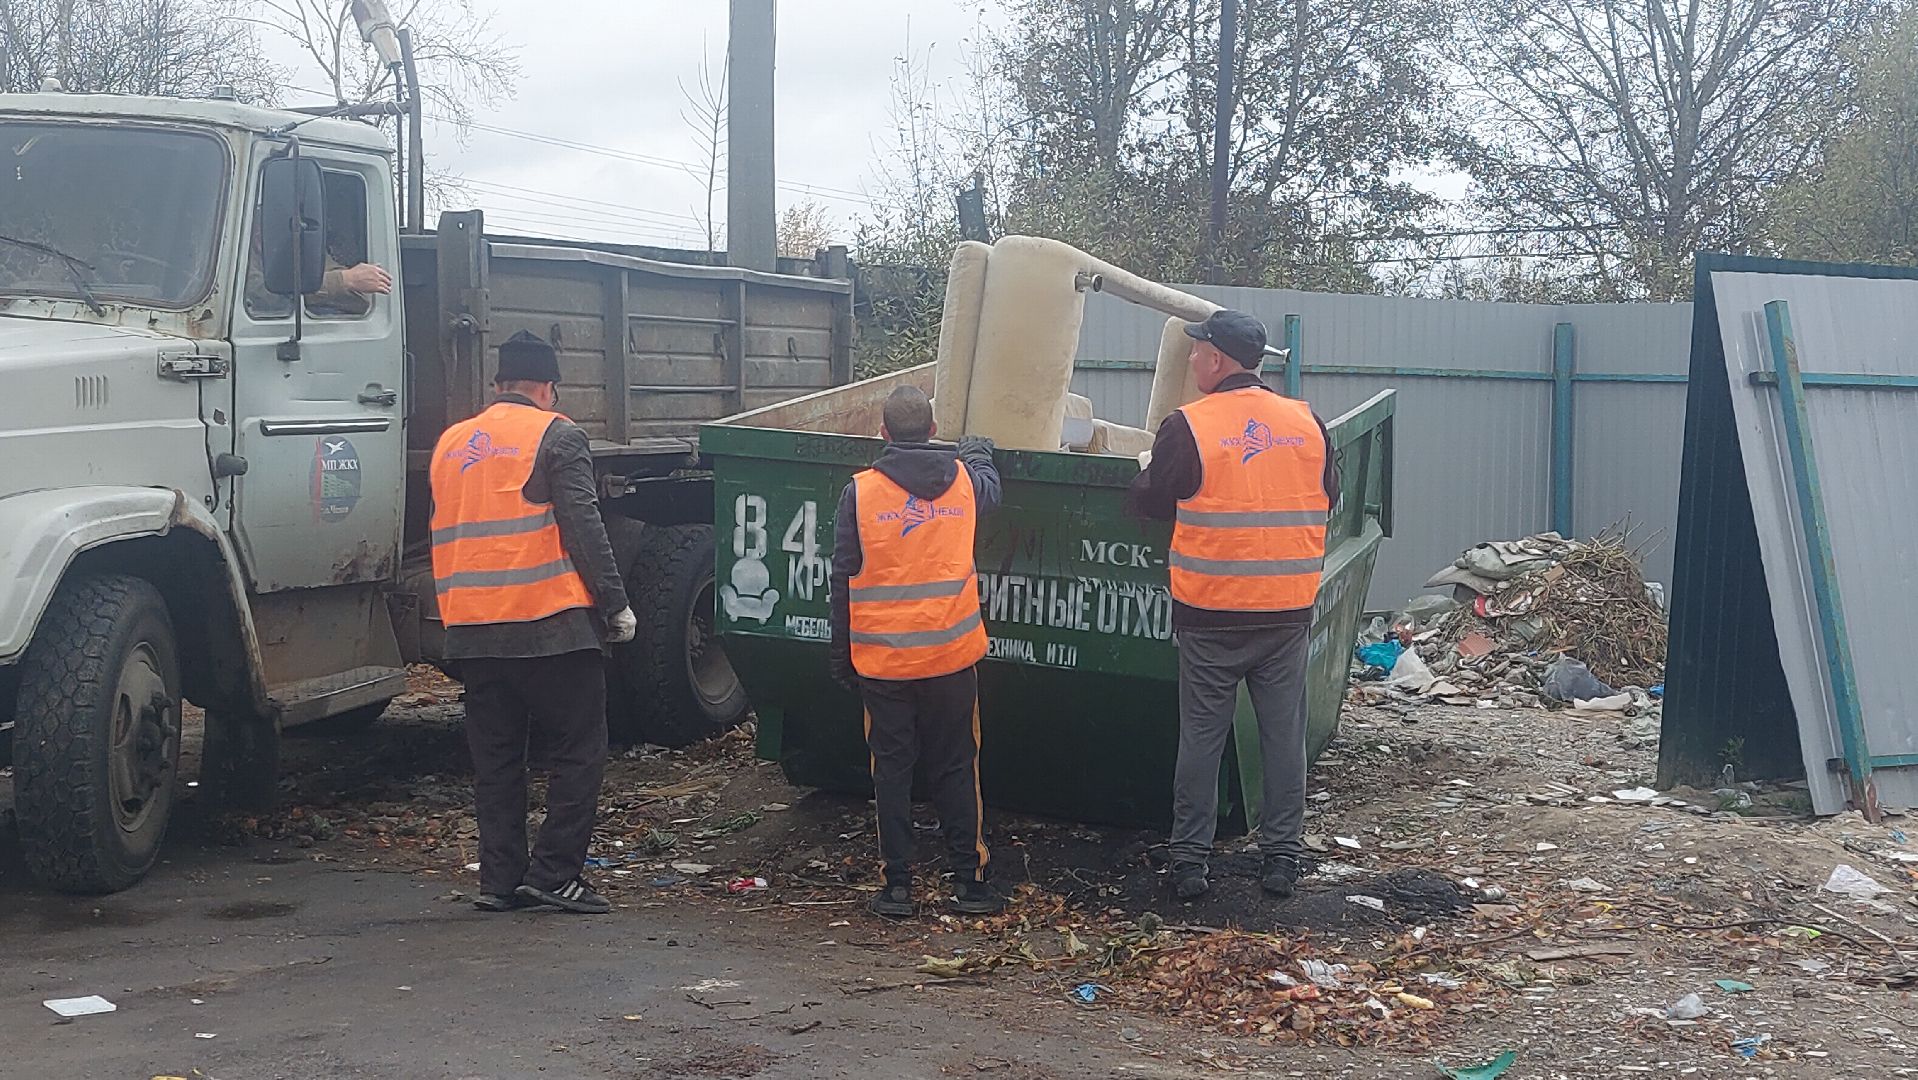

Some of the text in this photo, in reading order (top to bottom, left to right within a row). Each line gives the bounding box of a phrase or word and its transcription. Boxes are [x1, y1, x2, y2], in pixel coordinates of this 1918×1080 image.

[321, 459, 358, 471] МП ЖКХ
[1079, 539, 1164, 568] МСК-
[1097, 584, 1174, 640] ОТХО
[987, 636, 1037, 663] ЕХНИКА,
